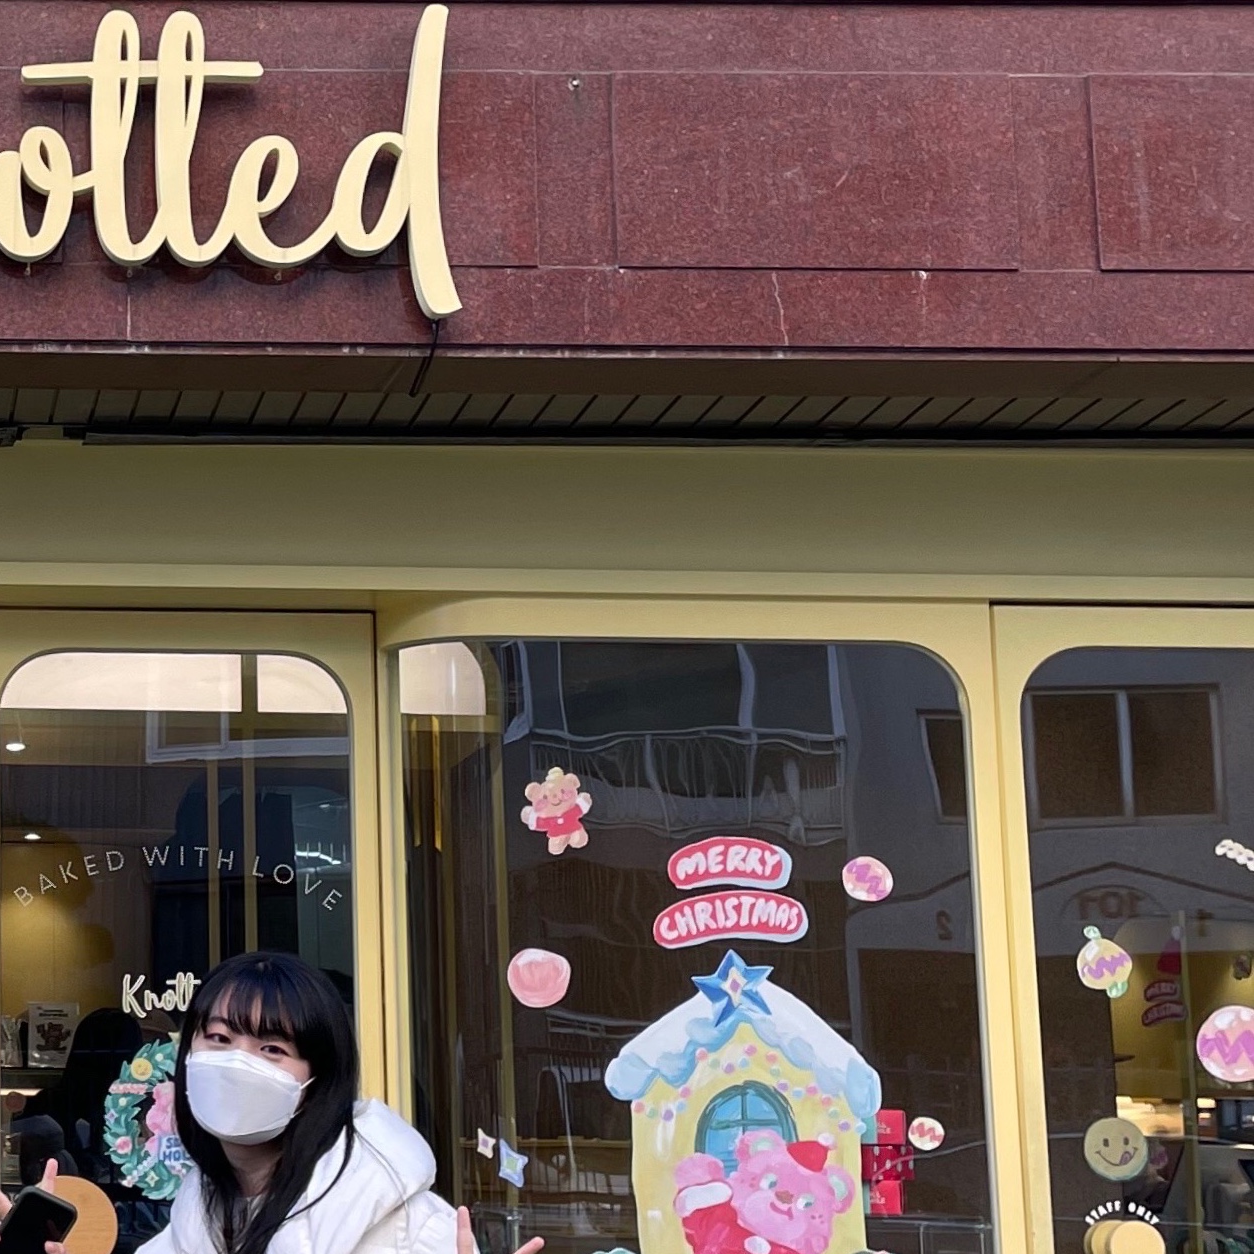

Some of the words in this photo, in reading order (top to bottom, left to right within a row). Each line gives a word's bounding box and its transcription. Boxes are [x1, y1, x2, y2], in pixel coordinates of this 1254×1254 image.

[13, 851, 125, 907] BAKED
[142, 846, 234, 871] WITH
[252, 856, 343, 911] LOVE
[676, 845, 781, 881] MERRY
[659, 896, 799, 940] CHRISTMAS
[122, 972, 202, 1018] Knott
[163, 1150, 191, 1162] HOL
[1085, 1200, 1121, 1225] STAFF
[1128, 1202, 1160, 1225] ONLY
